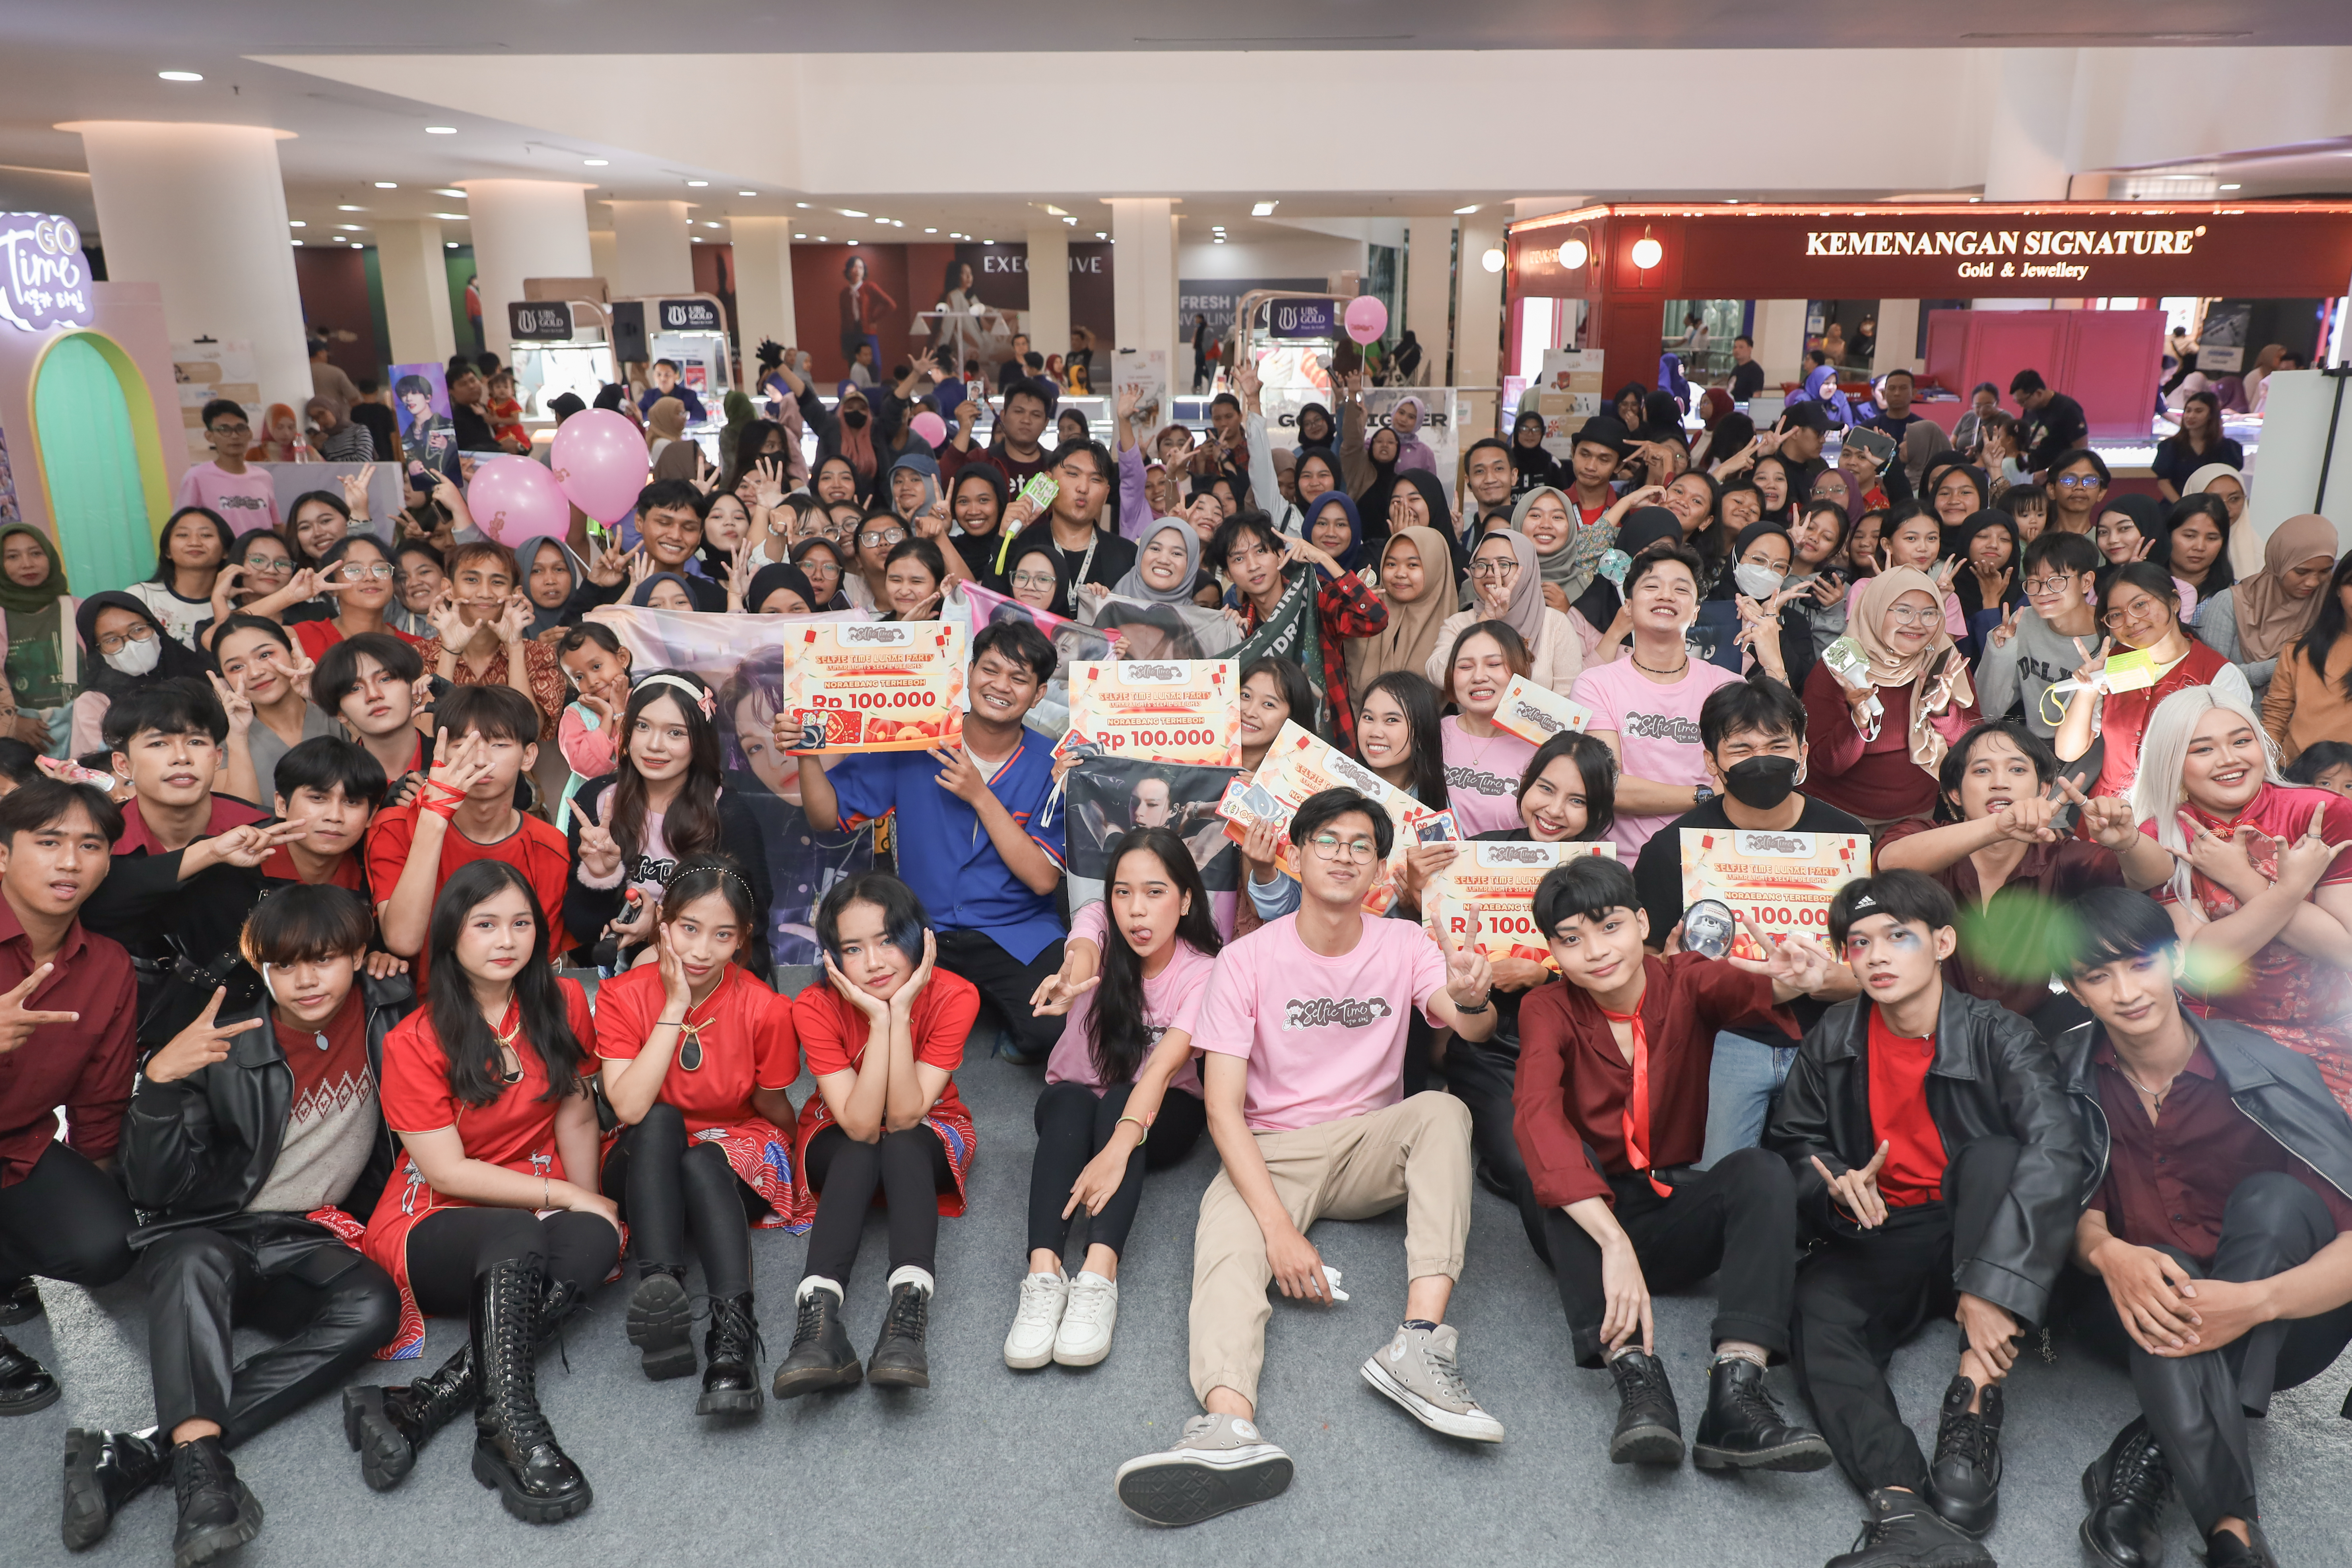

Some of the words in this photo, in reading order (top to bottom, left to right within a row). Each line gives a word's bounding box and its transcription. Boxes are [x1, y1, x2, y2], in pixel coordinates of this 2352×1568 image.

[35, 220, 78, 255] GO
[1805, 231, 2020, 256] KEMENANGAN
[0, 228, 80, 305] Time
[984, 256, 1102, 273] EXEIVE
[1958, 262, 1994, 278] Gold
[2000, 262, 2015, 278] &
[2020, 261, 2089, 281] Jewellery
[1180, 295, 1230, 309] FRESH
[688, 312, 713, 320] GOLD
[1300, 306, 1318, 315] UBS
[538, 318, 564, 328] GOLD
[1300, 314, 1325, 324] GOLD
[857, 628, 876, 640] Selfie
[876, 628, 893, 638] Time
[815, 655, 848, 664] SELFIE
[849, 654, 871, 663] TIME
[874, 654, 904, 662] LUNAR
[904, 653, 935, 662] PARTY
[1137, 666, 1155, 677] Selfie
[1154, 666, 1170, 676] Time
[824, 680, 879, 689] NORAEBANG
[813, 695, 842, 707] Rp
[849, 691, 936, 708] 100.000
[1130, 692, 1151, 700] TIME
[1183, 691, 1212, 700] PARTY
[1107, 718, 1159, 726] NORAEBANG
[1523, 706, 1542, 722] Selfie
[1541, 715, 1556, 727] Time
[1640, 717, 1671, 736] Selfie
[1670, 720, 1698, 737] Time
[1096, 731, 1125, 750] Rp
[1131, 729, 1215, 747] 100.000
[1295, 763, 1324, 786] SELFIE
[1340, 763, 1358, 778] Selfie
[1356, 773, 1372, 786] Time
[1446, 769, 1478, 787] Selfie
[1477, 774, 1503, 788] Time
[1300, 776, 1319, 792] LUNAR
[1756, 836, 1776, 849] Selfie
[1775, 838, 1793, 848] Time
[1498, 848, 1519, 860] Selfie
[1518, 848, 1535, 859] Time
[1714, 863, 1748, 873] SELFIE
[1749, 864, 1772, 874] TIME
[1775, 865, 1807, 875] LUNAR
[1808, 866, 1840, 876] PARTY
[1454, 876, 1488, 885] SELFIE
[1490, 876, 1513, 885] TIME
[1724, 891, 1782, 901] NORAEBANG
[1783, 893, 1833, 903] TERHEBOH
[1855, 901, 1877, 910] adidas
[1303, 1001, 1339, 1025] Selfie
[1338, 1001, 1368, 1022] Time
